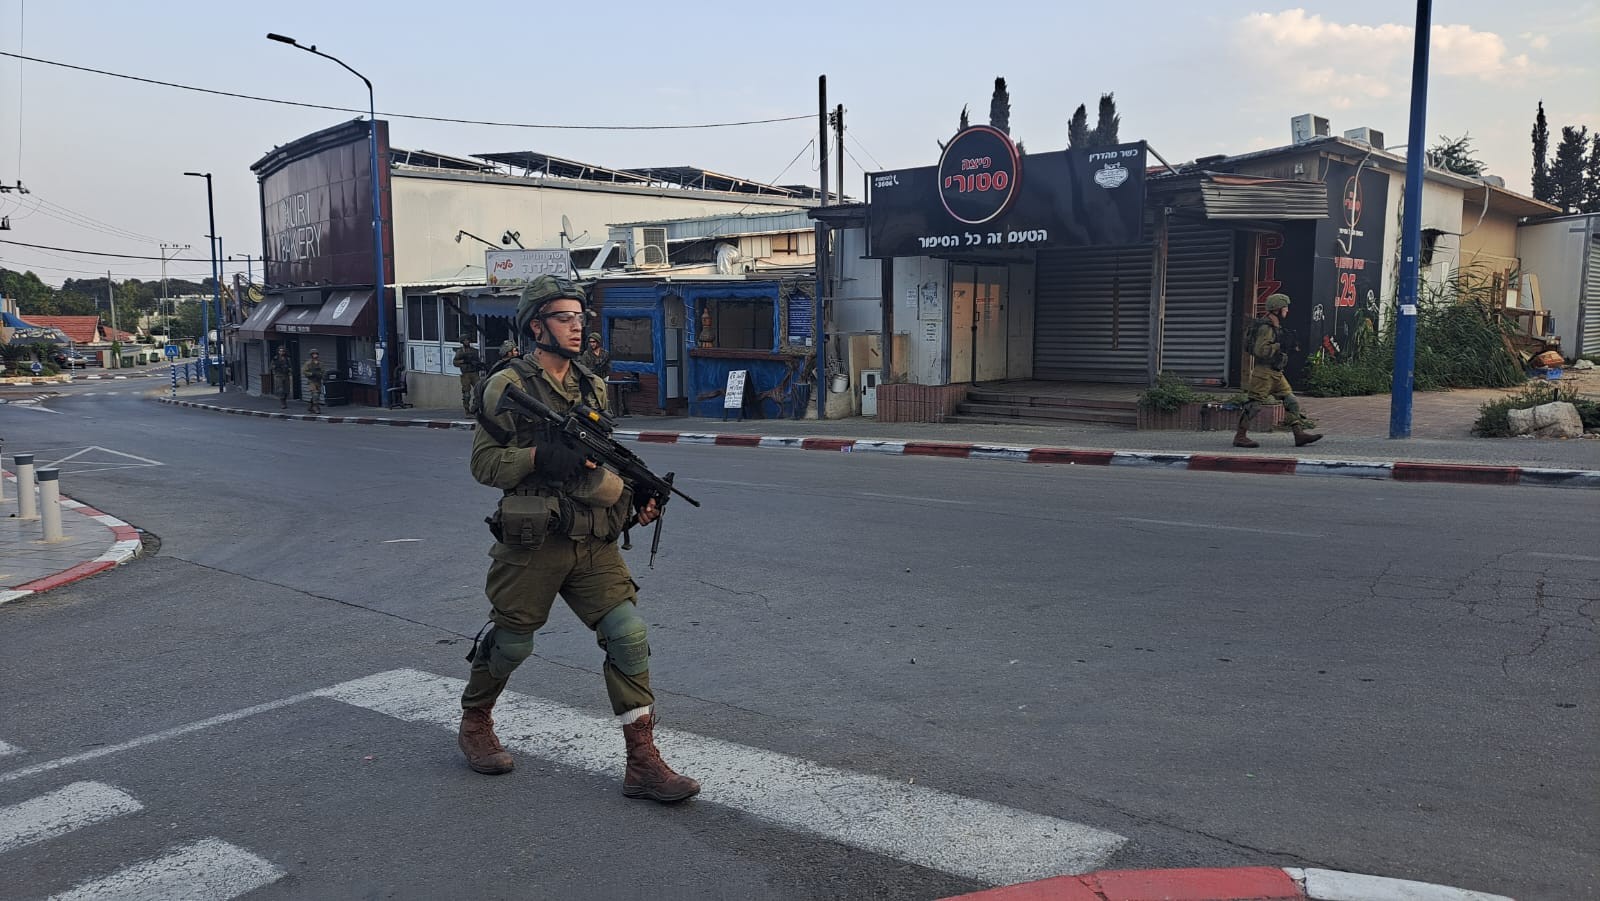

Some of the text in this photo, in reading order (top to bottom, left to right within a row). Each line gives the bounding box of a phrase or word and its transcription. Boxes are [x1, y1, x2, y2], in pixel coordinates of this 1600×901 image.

[961, 156, 992, 171] פיצה
[1088, 149, 1138, 163] כשר מהדרין
[944, 170, 1009, 193] סטורי
[280, 224, 322, 262] BAKERY
[918, 229, 1048, 249] הטעם זה כל הסיפור
[521, 259, 568, 274] גלידה
[1340, 272, 1357, 307] 25
